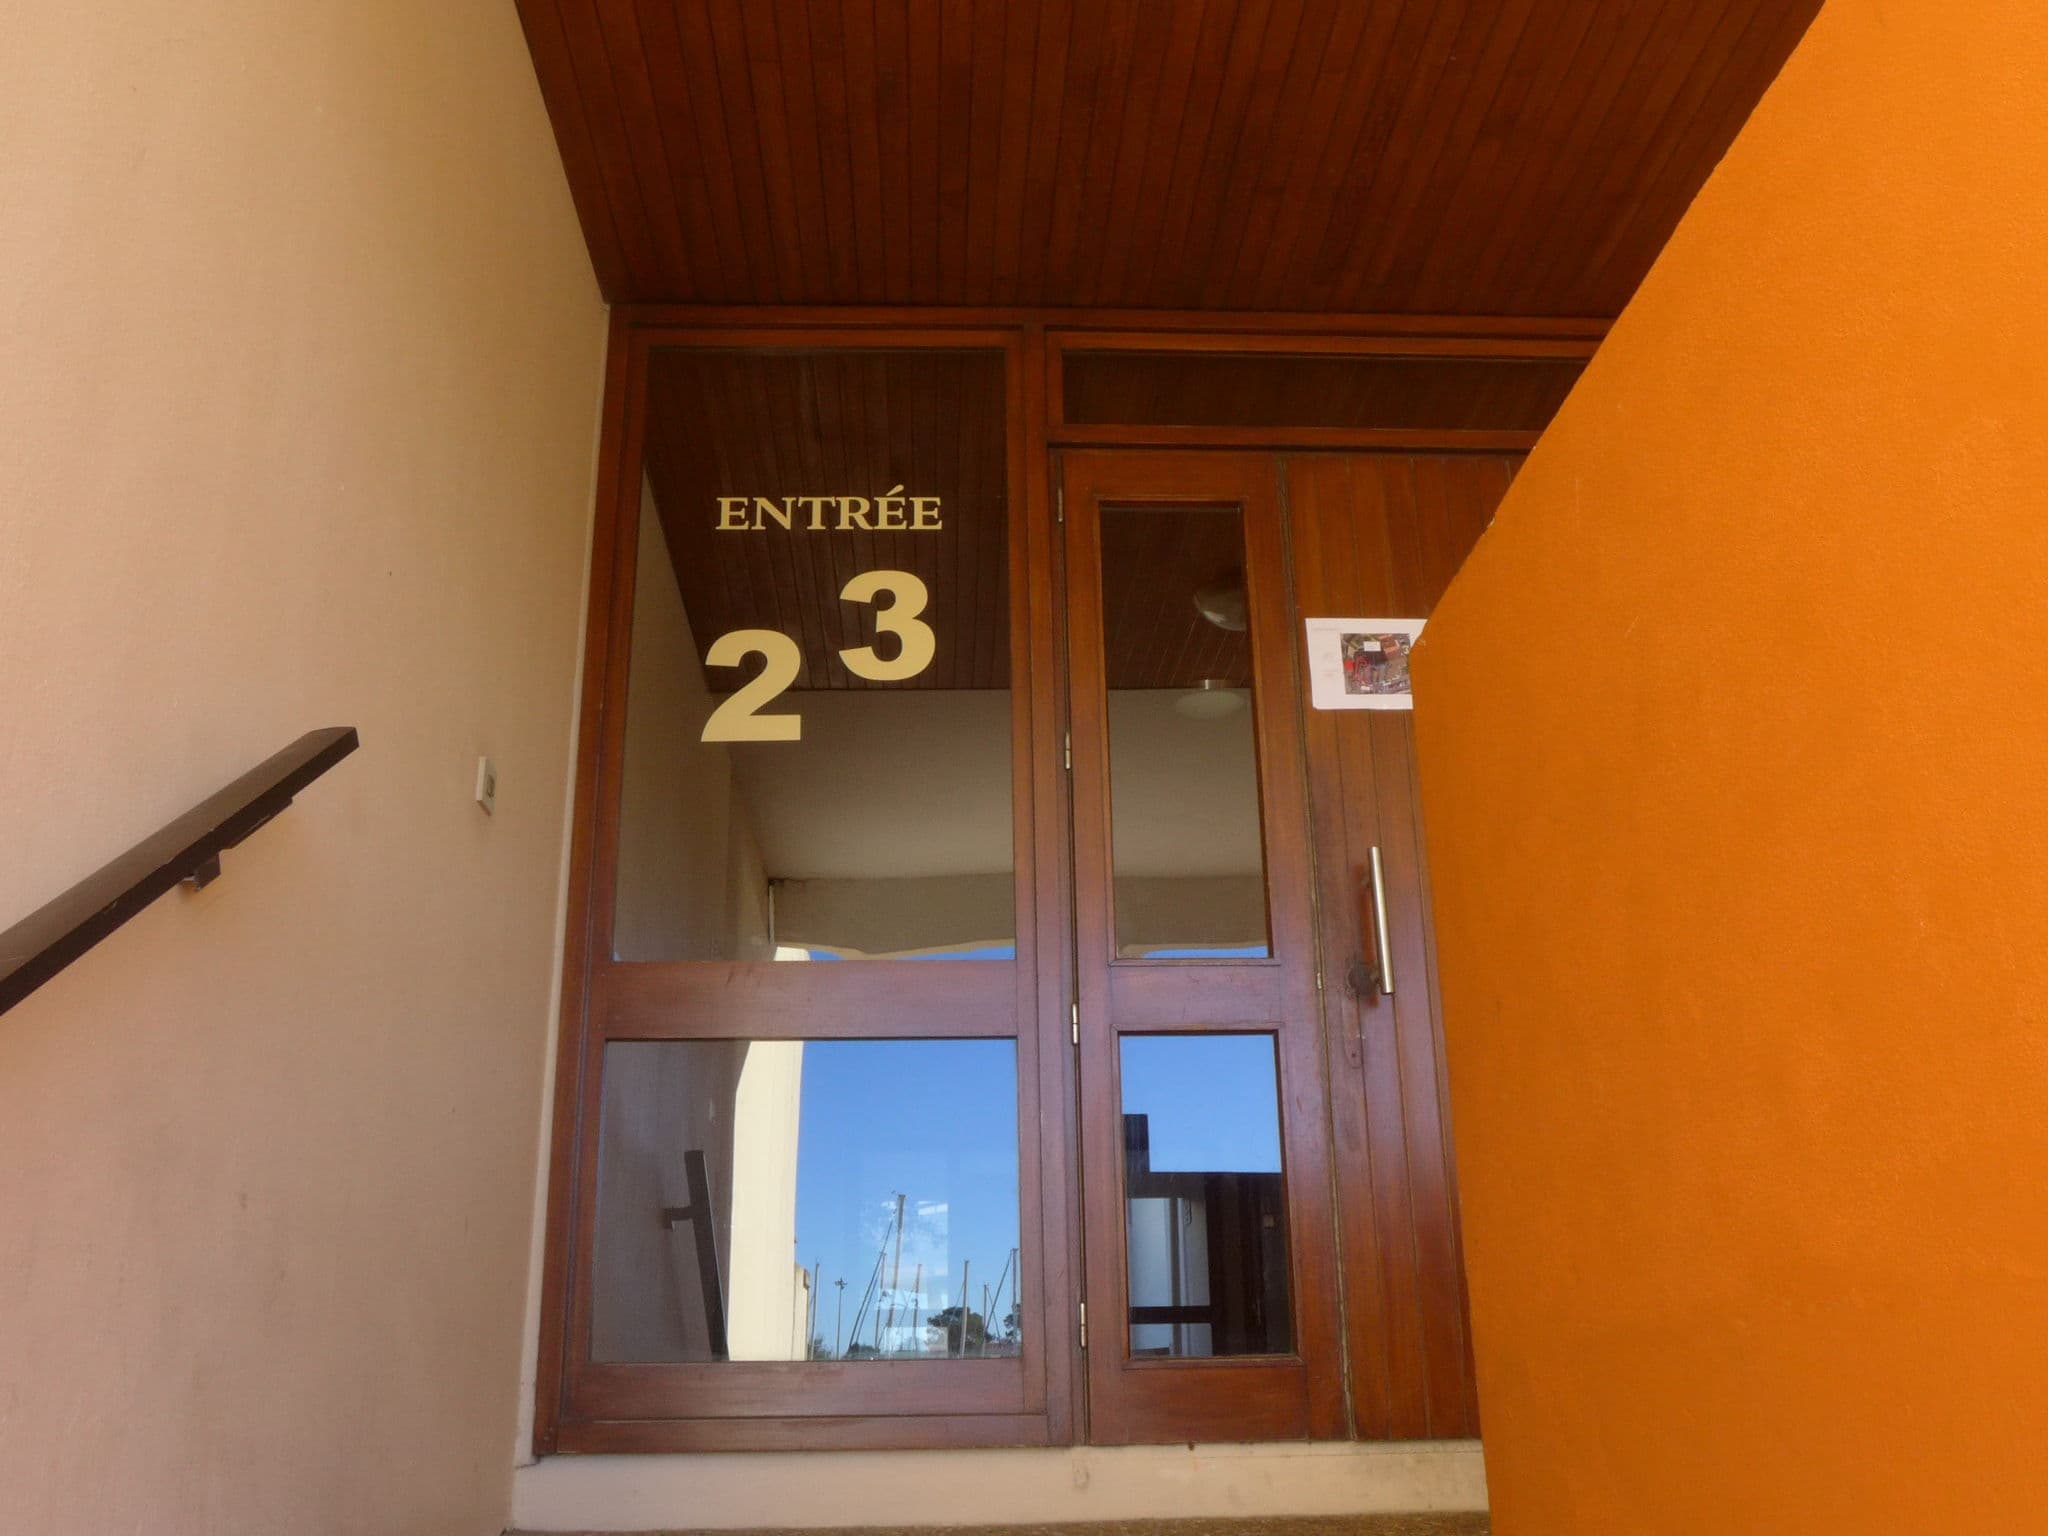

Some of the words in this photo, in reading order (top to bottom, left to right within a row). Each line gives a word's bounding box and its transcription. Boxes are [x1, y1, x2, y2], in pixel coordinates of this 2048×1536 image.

[715, 484, 943, 531] ENTRÉE
[701, 629, 801, 742] 2
[838, 570, 936, 681] 3
